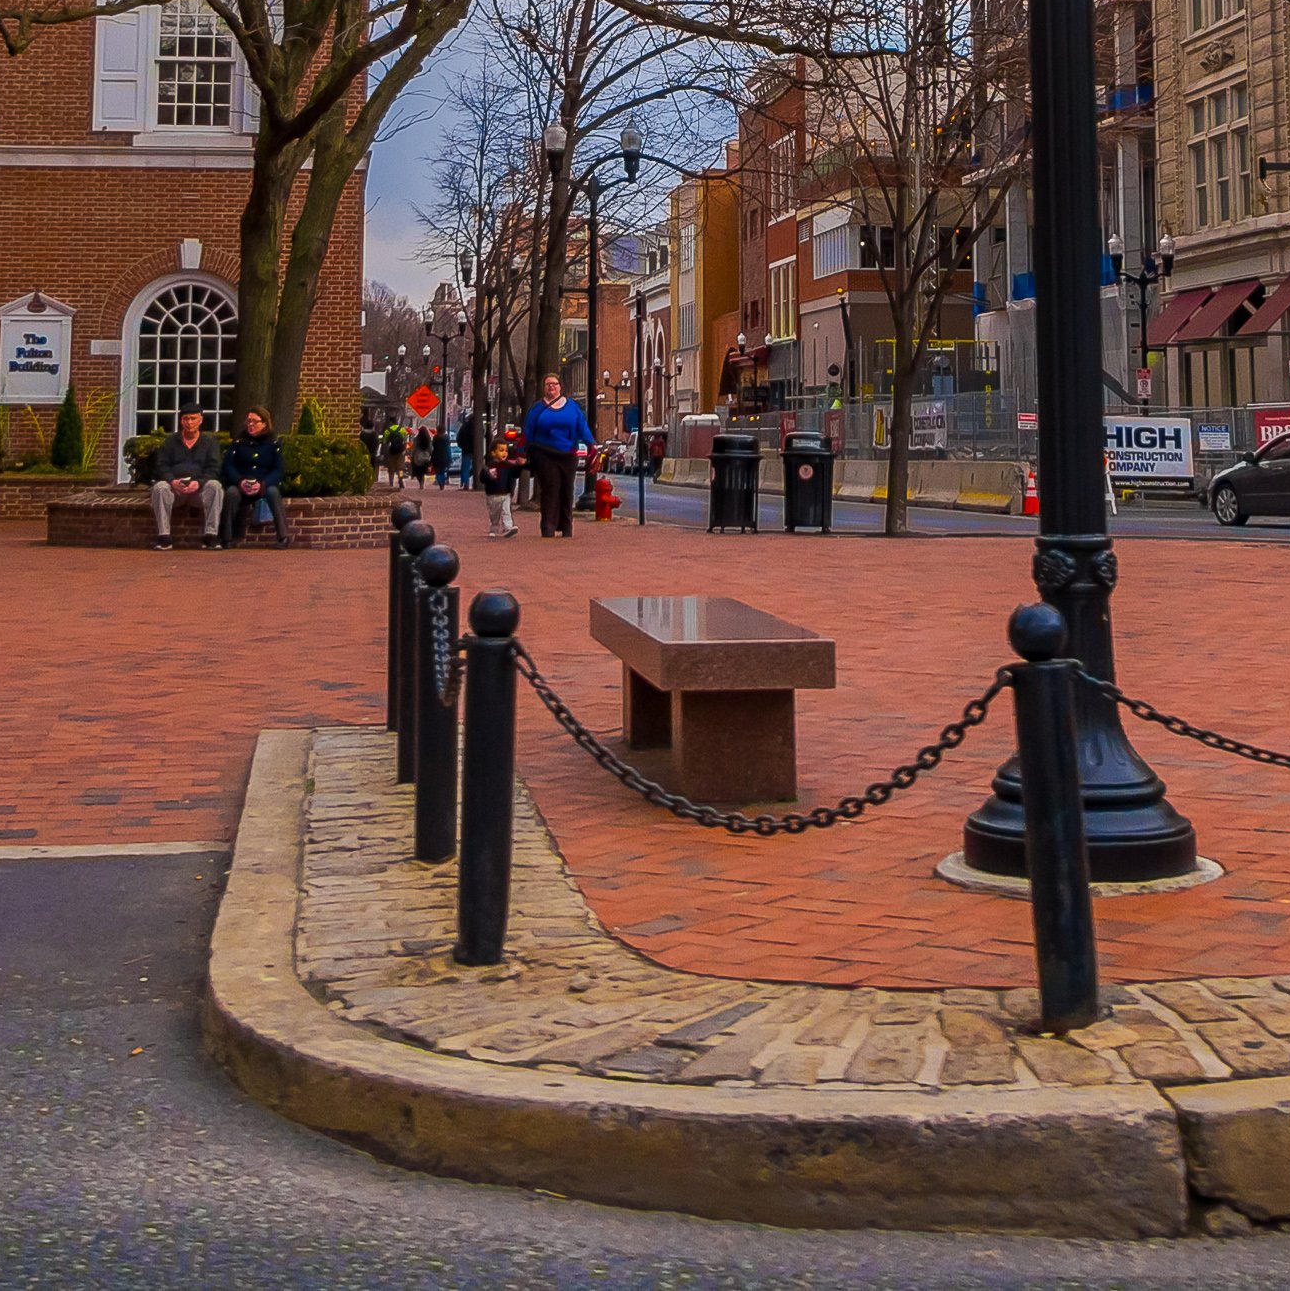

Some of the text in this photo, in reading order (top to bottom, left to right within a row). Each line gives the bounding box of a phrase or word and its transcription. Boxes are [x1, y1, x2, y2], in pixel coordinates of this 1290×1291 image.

[23, 333, 47, 345] The
[9, 361, 60, 375] Building
[1103, 426, 1182, 450] HIGH
[1109, 461, 1156, 473] OMPANY
